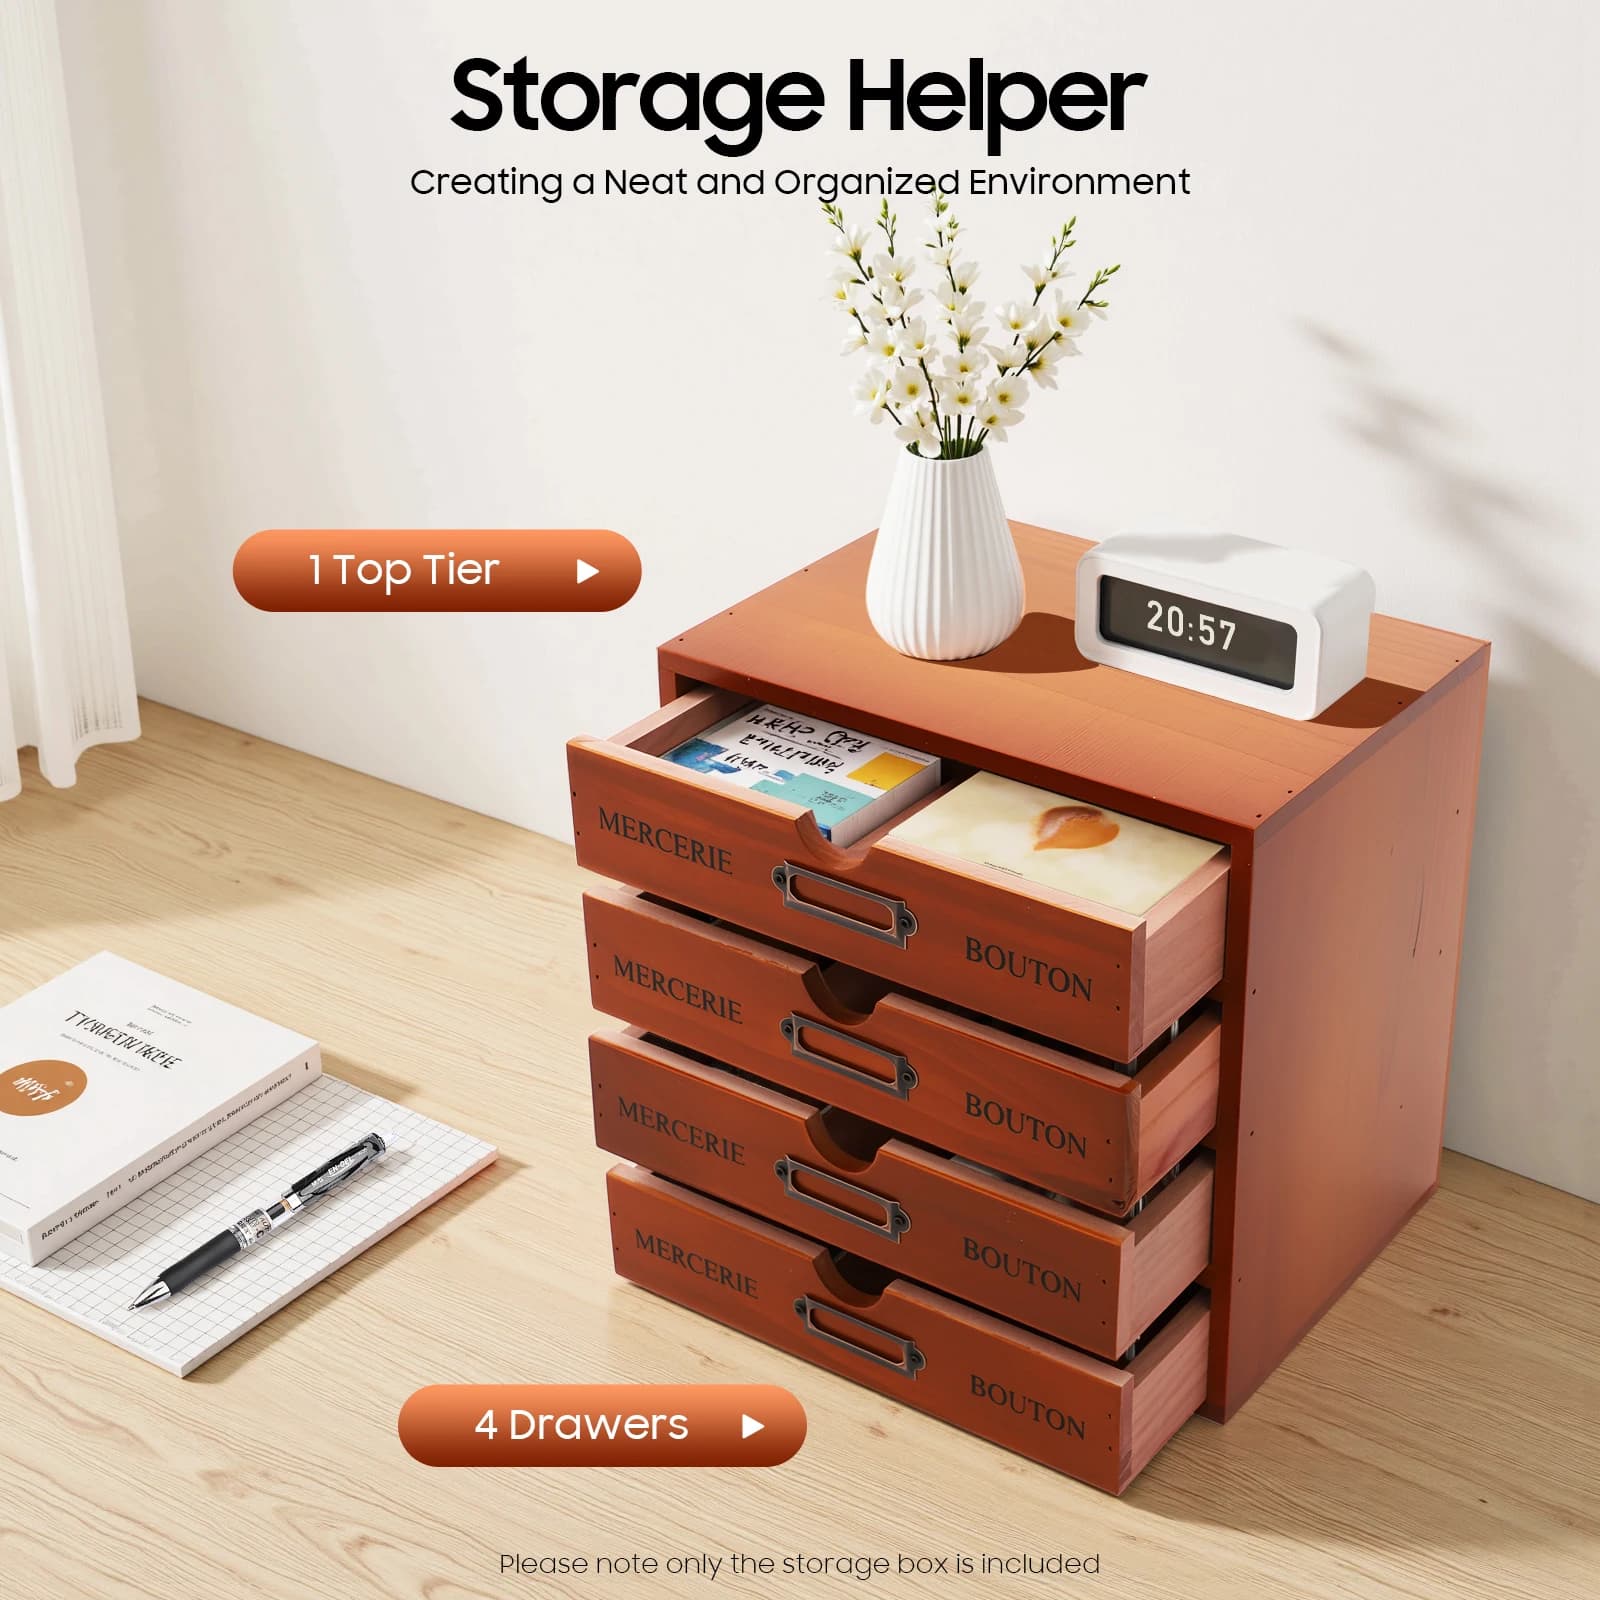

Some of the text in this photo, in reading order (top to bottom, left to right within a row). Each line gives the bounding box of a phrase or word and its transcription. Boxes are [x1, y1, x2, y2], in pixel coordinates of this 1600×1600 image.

[1147, 600, 1235, 650] 20:57
[599, 808, 1092, 1001] MERCERIE BOUTON
[613, 955, 1087, 1159] MERCERIE BOUTON
[618, 1096, 1081, 1303] MERCERIE BOUTON
[635, 1229, 1086, 1439] MERCERIE BOUTON
